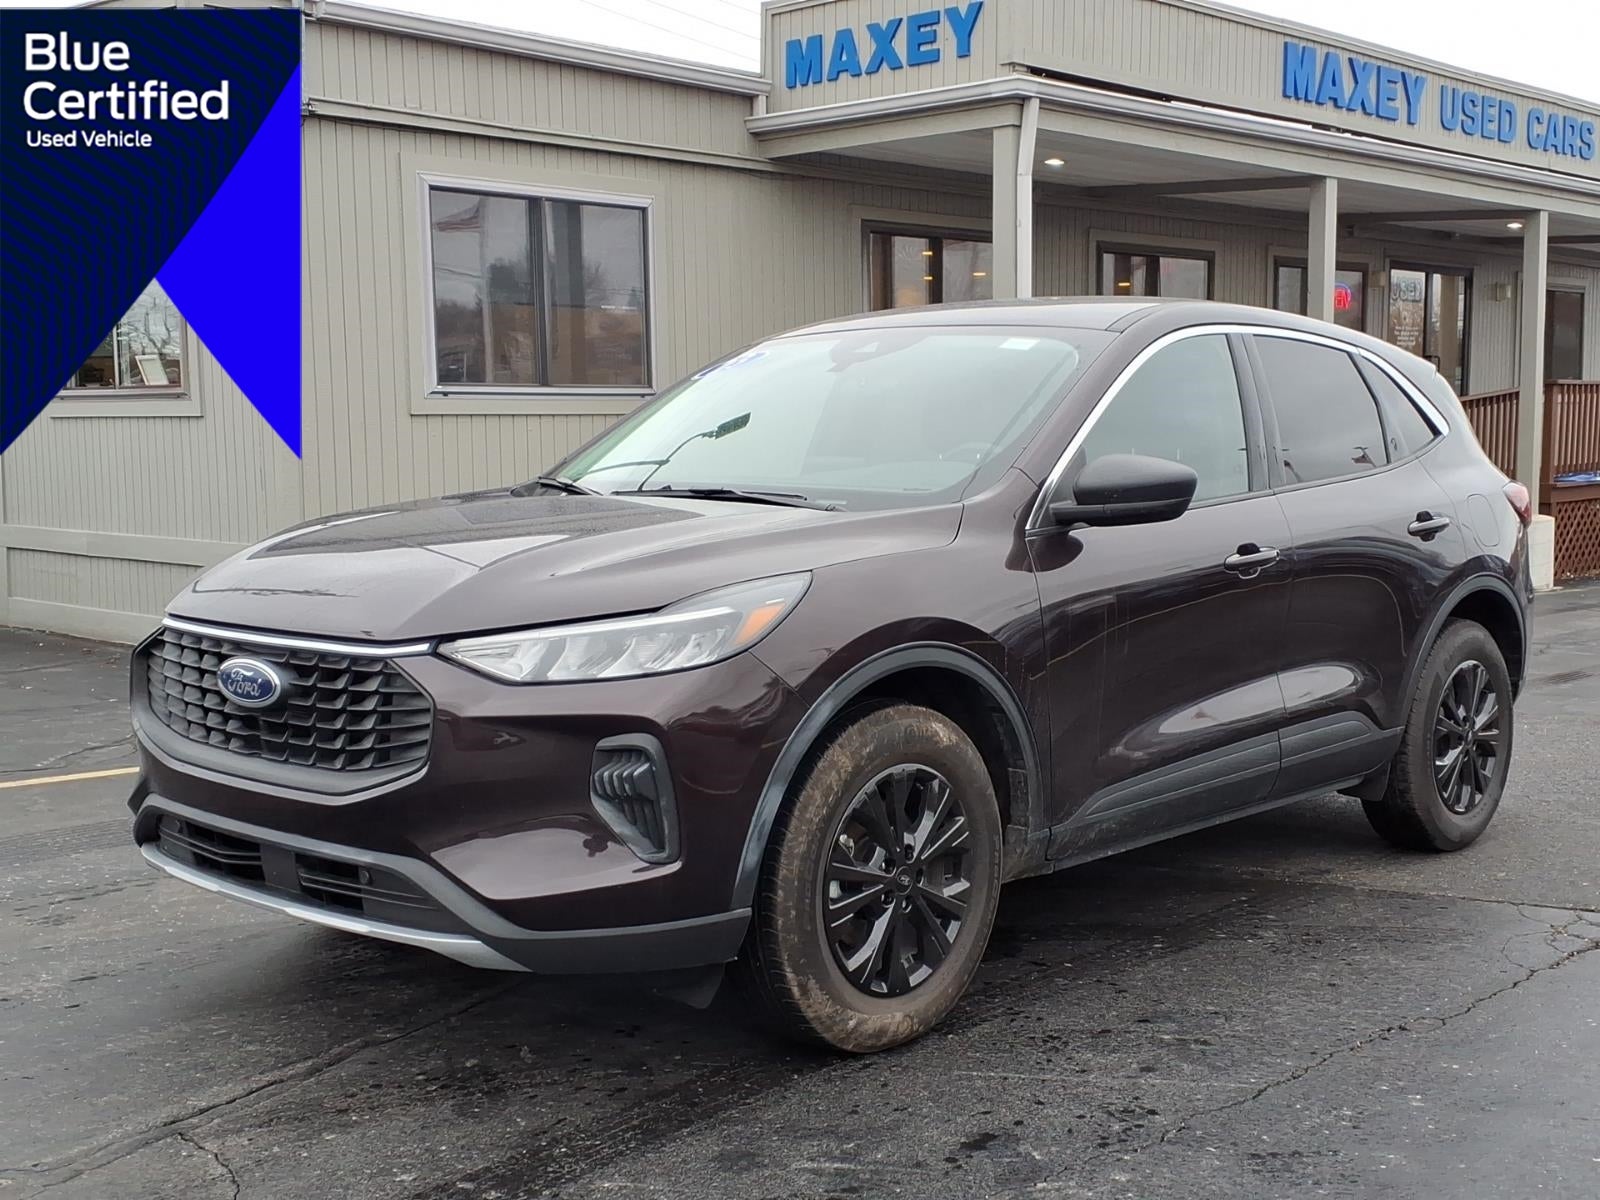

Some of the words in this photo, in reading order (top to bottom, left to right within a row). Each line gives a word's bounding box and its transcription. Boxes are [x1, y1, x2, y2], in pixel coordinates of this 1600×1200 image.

[786, 1, 983, 89] MAXEY
[1282, 41, 1427, 125] MAXEY
[1440, 84, 1517, 143] USED
[1527, 107, 1595, 160] CARS
[227, 668, 262, 697] Ford
